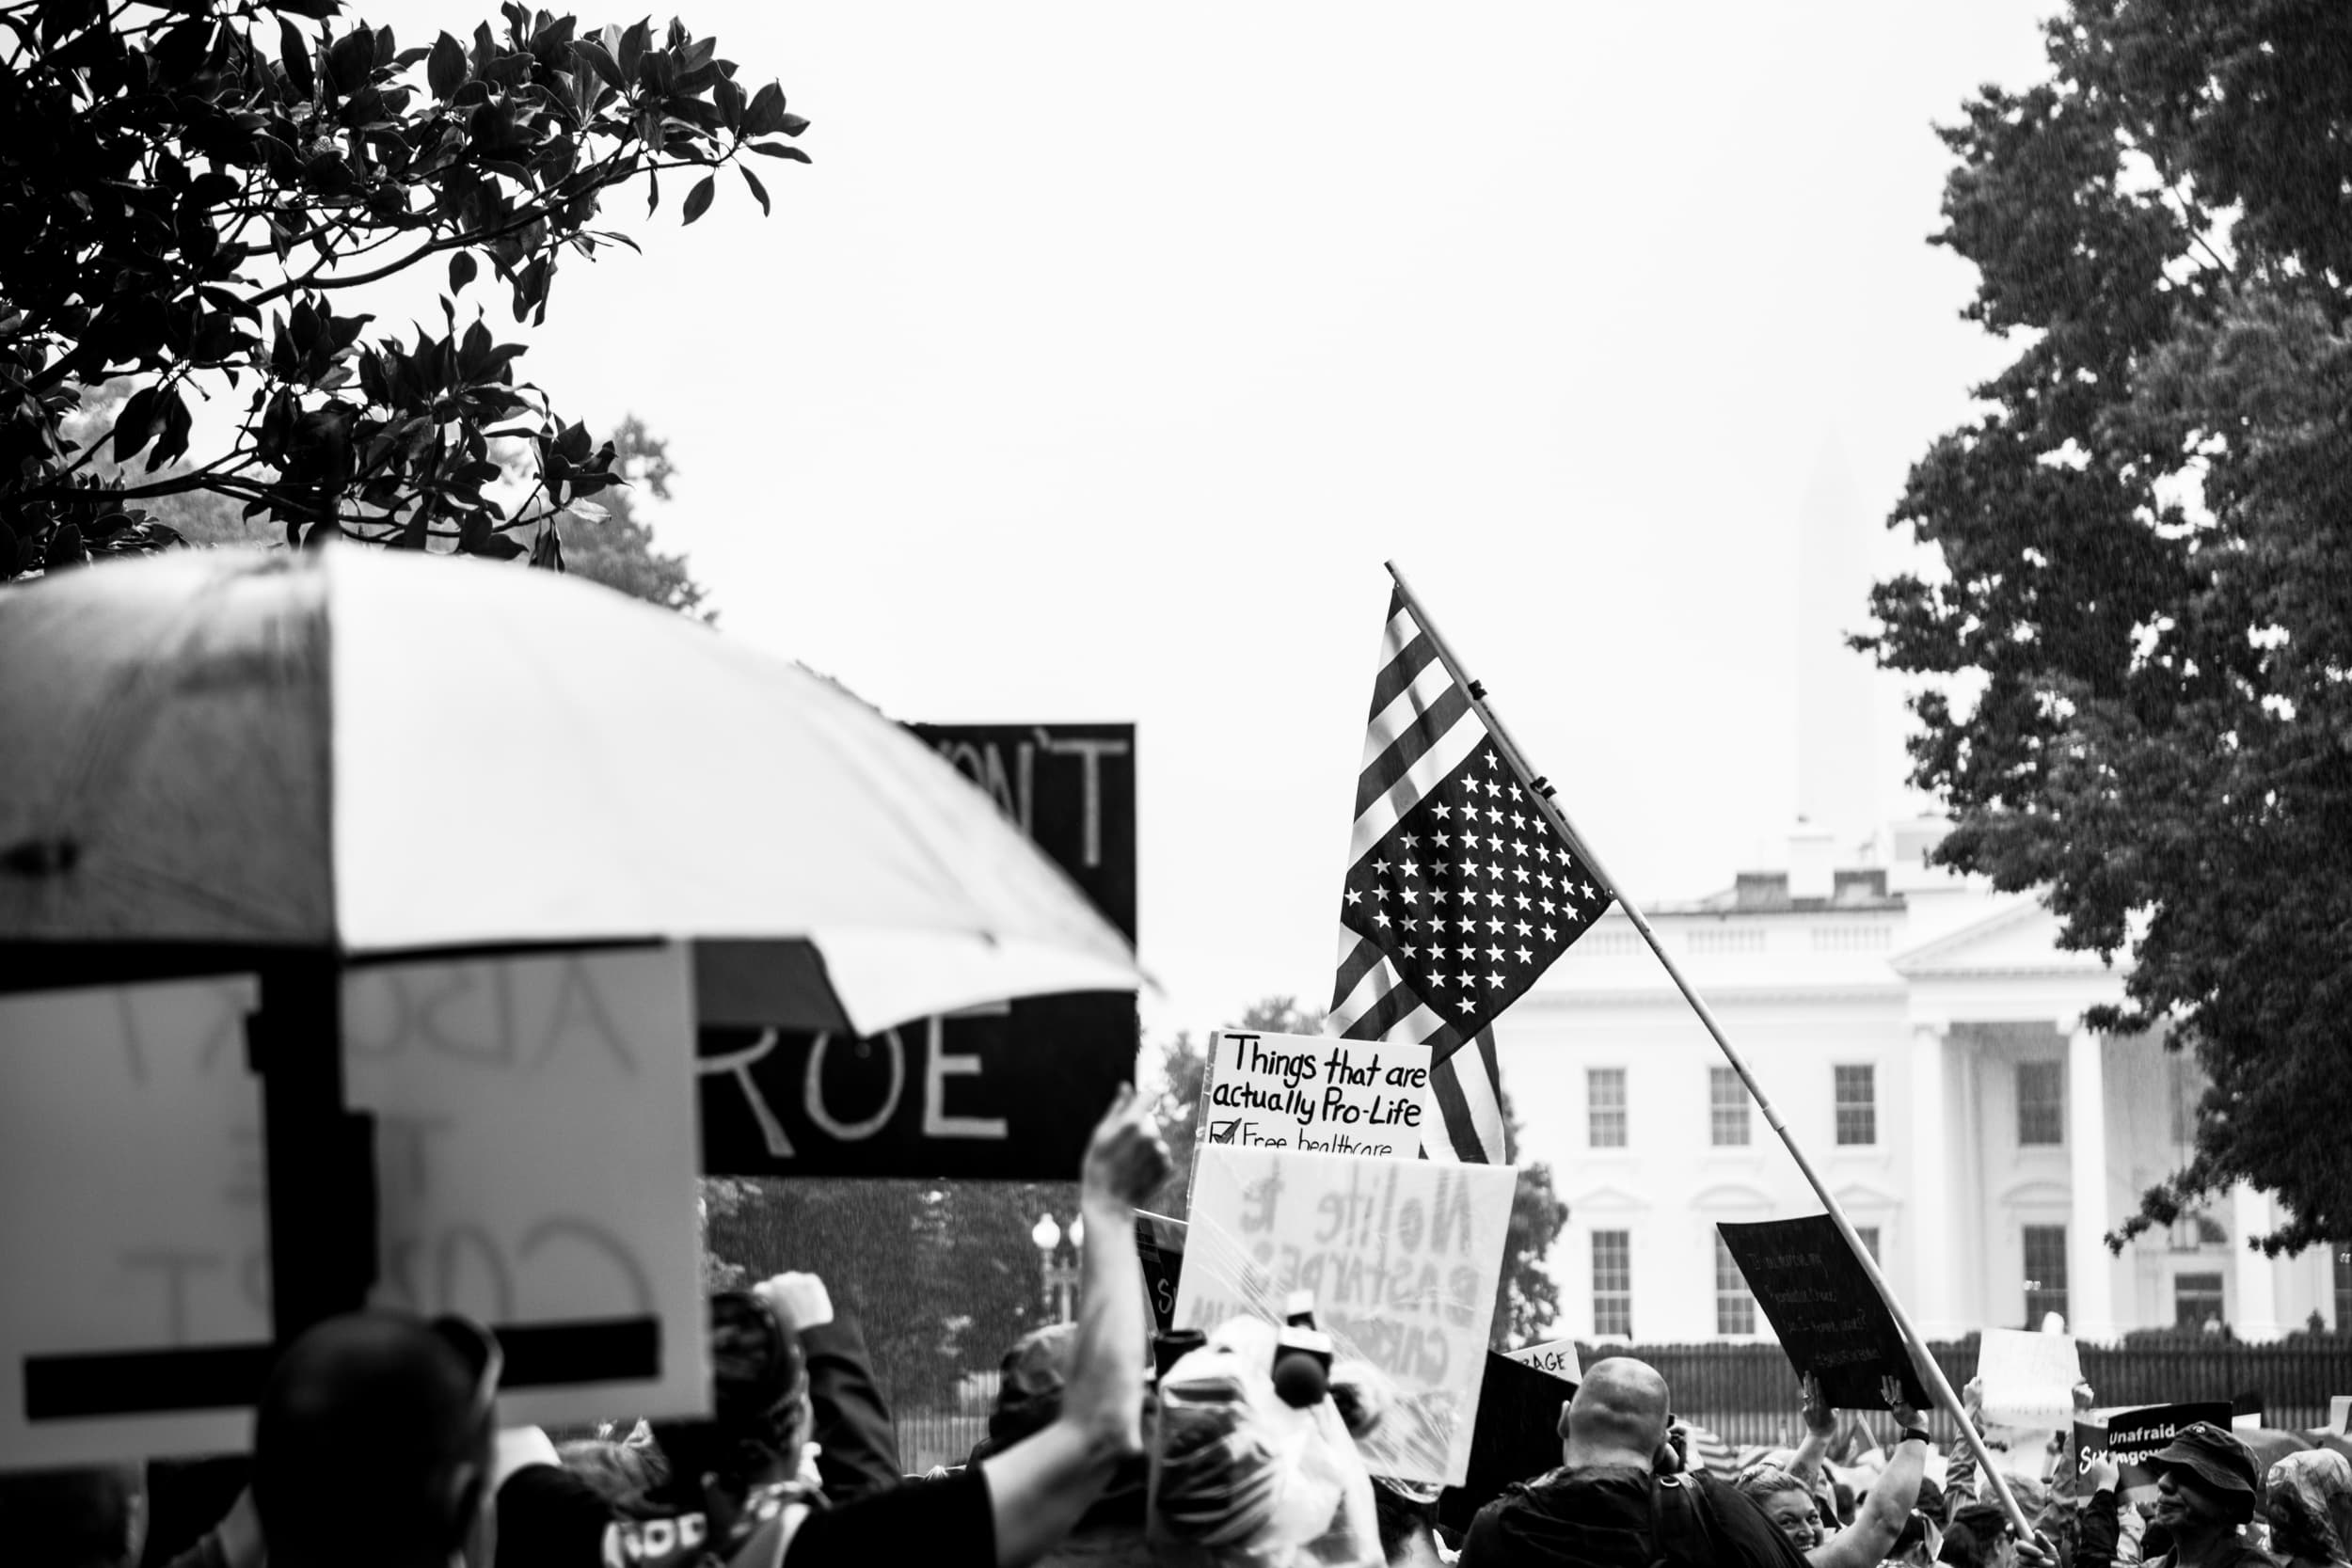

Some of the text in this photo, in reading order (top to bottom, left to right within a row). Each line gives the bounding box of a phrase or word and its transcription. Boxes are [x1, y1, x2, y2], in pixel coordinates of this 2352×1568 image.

[1224, 1034, 1427, 1089] Things that are
[1213, 1082, 1422, 1127] actually Pro-Life
[1243, 1122, 1288, 1148] Free
